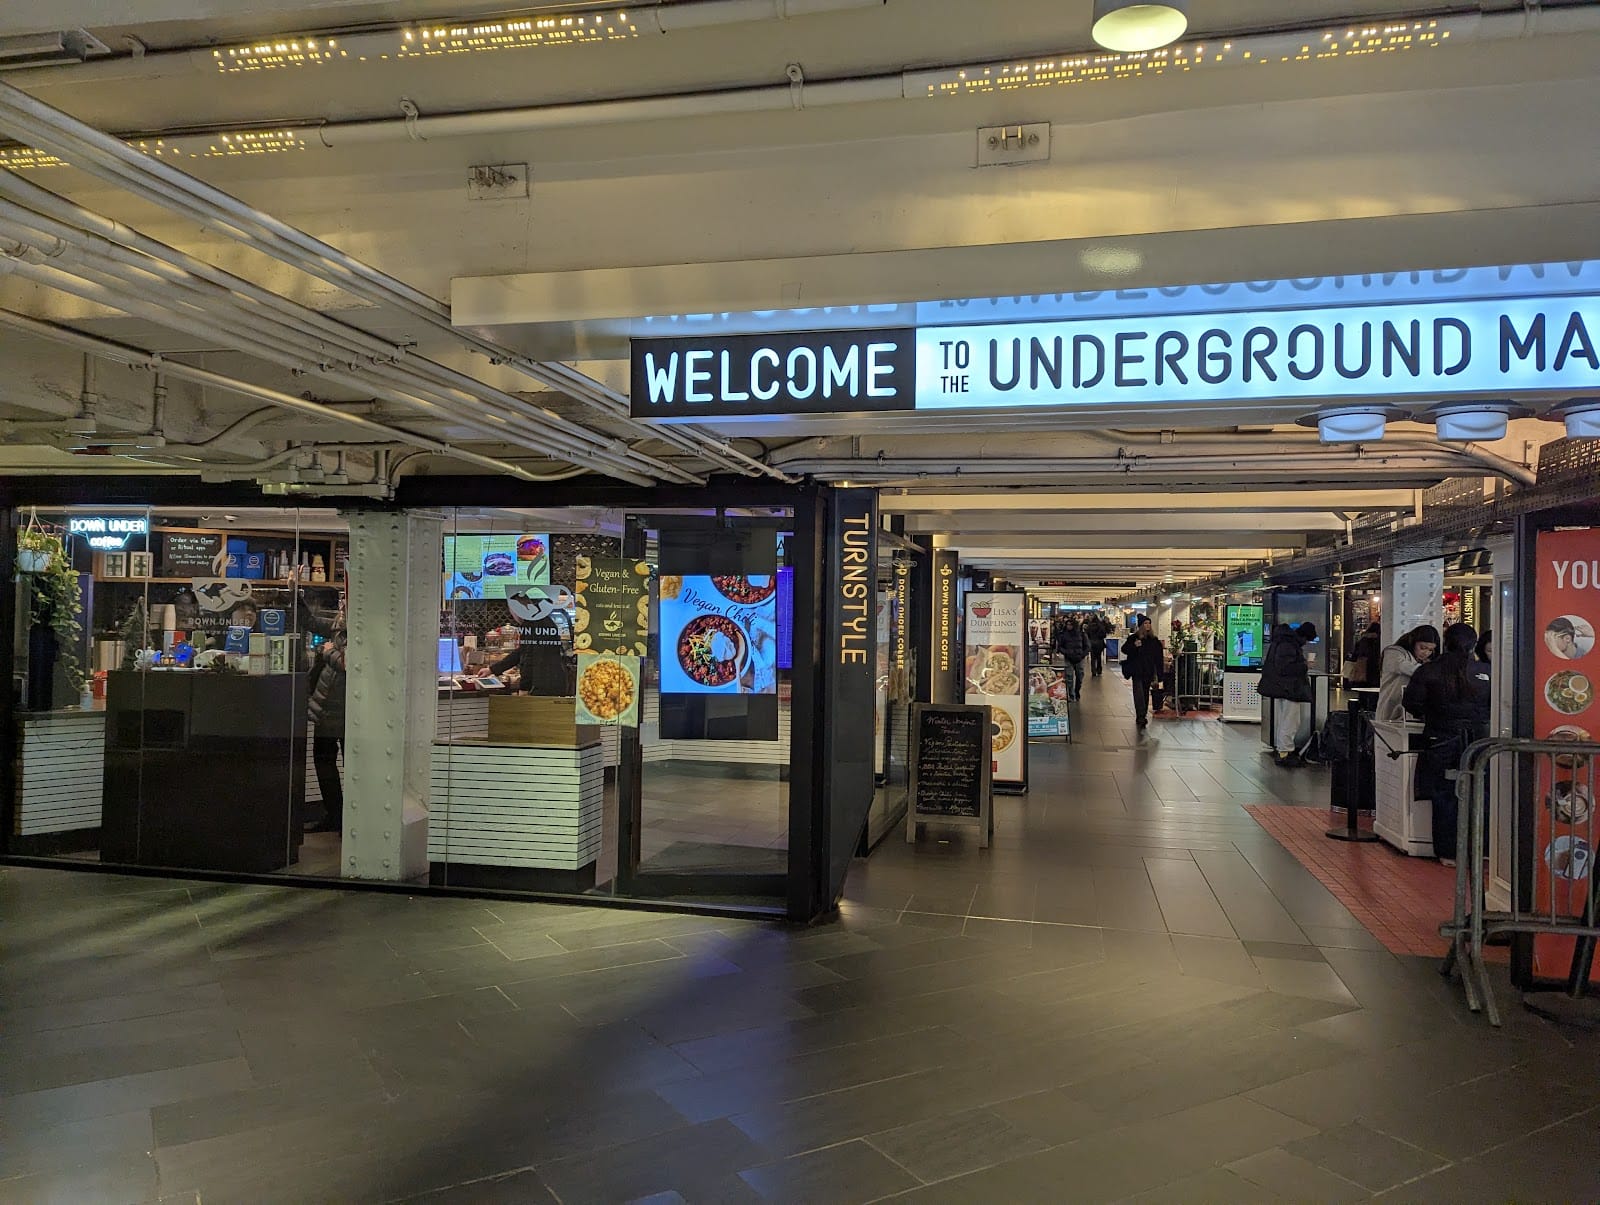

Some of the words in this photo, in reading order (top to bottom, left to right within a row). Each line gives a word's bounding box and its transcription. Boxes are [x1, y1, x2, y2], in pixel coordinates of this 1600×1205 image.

[645, 342, 898, 404] WELCOME
[939, 340, 970, 370] TO
[989, 317, 1471, 392] UNDERGROUND
[1499, 311, 1600, 373] MA
[940, 375, 969, 393] THE
[70, 519, 105, 532] DOWN
[108, 519, 145, 532] UNDER
[90, 536, 123, 549] coffee
[595, 567, 621, 580] Vegan
[621, 569, 630, 578] &
[840, 512, 869, 665] TURNSTYLE
[942, 579, 950, 605] DOWN
[682, 588, 722, 615] Vegan
[725, 604, 758, 627] Chili
[993, 608, 1017, 616] LISA'S
[1464, 588, 1474, 628] TURNSTYL
[188, 618, 216, 626] DOWN
[219, 618, 250, 627] UNDER
[941, 607, 949, 636] UNDER
[970, 619, 1017, 627] DUMPLINGS
[941, 638, 949, 671] COFFEE
